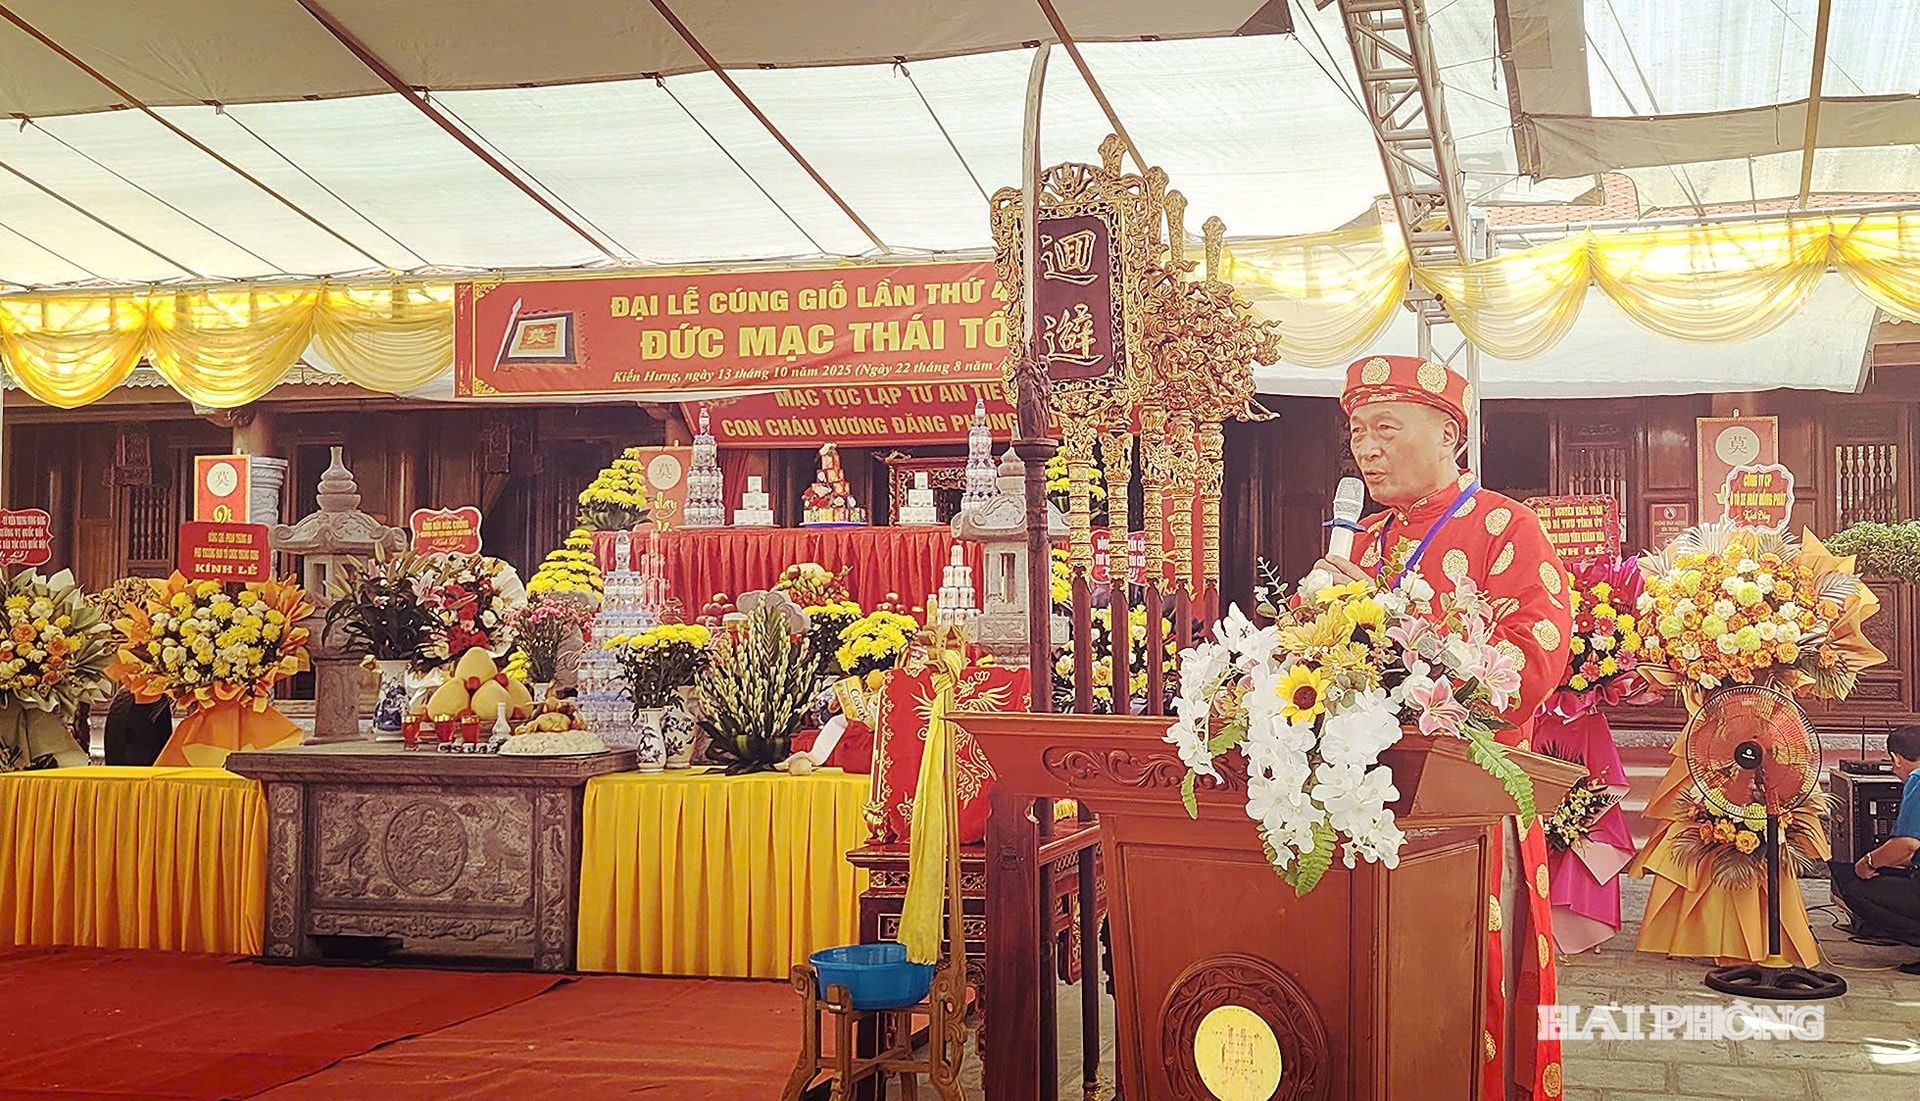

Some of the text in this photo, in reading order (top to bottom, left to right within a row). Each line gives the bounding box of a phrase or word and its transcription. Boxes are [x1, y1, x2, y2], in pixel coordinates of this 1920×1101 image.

[610, 294, 659, 321] ĐẠI
[667, 286, 700, 316] LỄ
[709, 287, 789, 314] CÚNG
[799, 280, 848, 311] GIỖ
[857, 278, 915, 309] LẦN
[924, 276, 985, 306] THỨ
[640, 322, 725, 361] ĐỨC
[738, 323, 835, 362] MẠC
[848, 313, 945, 353] THÁI
[612, 368, 640, 383] Kiến
[685, 369, 715, 383] ngày
[718, 368, 732, 380] 13
[735, 367, 769, 381] tháng
[774, 366, 788, 378] 10
[791, 367, 818, 377] năm
[821, 364, 852, 377] 2025
[855, 363, 892, 378] (Ngày
[894, 362, 910, 375] 22
[913, 360, 950, 375] tháng
[953, 360, 962, 372] 8
[965, 360, 992, 371] năm
[774, 388, 821, 410] MẠC
[721, 418, 763, 437] CON
[765, 415, 819, 437] CHÁU
[820, 415, 890, 436] HƯƠNG
[891, 412, 948, 434] ĐĂNG
[194, 562, 233, 575] KÍNH
